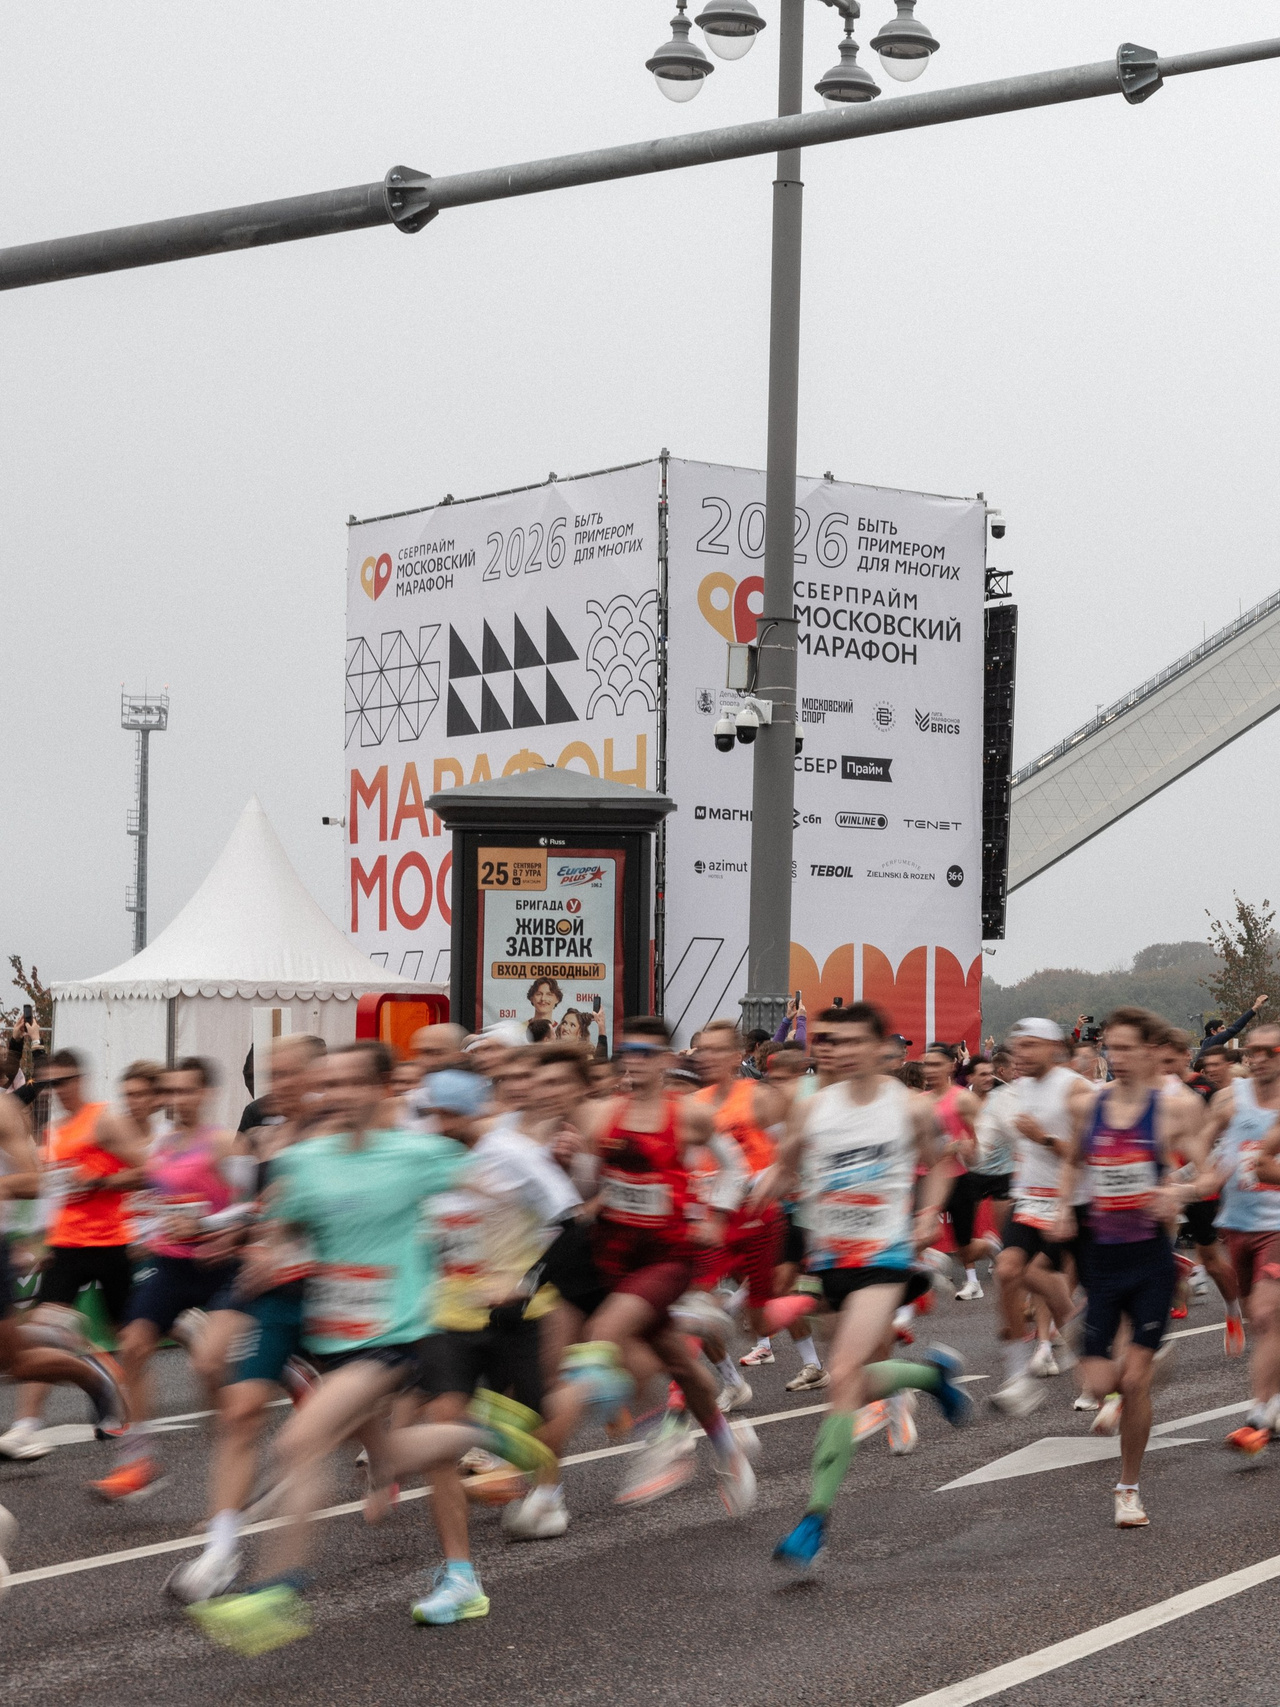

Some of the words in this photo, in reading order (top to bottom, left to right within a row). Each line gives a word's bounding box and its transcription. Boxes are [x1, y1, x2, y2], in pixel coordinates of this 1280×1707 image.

[574, 512, 603, 528] БЫТЬ
[857, 517, 898, 535] БЫТЬ
[574, 522, 634, 545] ПРИМЕРОМ
[398, 538, 455, 560] СБЕРПРАЙМ
[482, 516, 567, 582] 2026
[573, 546, 595, 565] ДЛЯ
[597, 537, 644, 558] МНОГИХ
[857, 536, 946, 560] ПРИМЕРОМ
[396, 548, 476, 579] МОСКОВСКИЙ
[857, 555, 890, 573] ДЛЯ
[894, 559, 961, 580] МНОГИХ
[396, 574, 454, 597] МАРАФОН
[793, 580, 918, 610] СБЕРПРАЙМ
[793, 604, 961, 642] МОСКОВСКИЙ
[797, 633, 917, 665] МАРАФОН
[802, 697, 854, 714] МОСКОВСКИЙ
[802, 710, 826, 724] СПОРТ
[931, 722, 960, 734] BRICS
[793, 756, 837, 774] СБЕР
[846, 761, 883, 776] Прайм
[709, 808, 753, 821] магн
[802, 814, 822, 824] сбп
[839, 815, 876, 826] WINLINE
[903, 819, 962, 831] TENET
[481, 861, 509, 886] 25
[512, 869, 518, 877] В
[519, 869, 524, 877] 7
[525, 869, 542, 877] УТРА
[708, 859, 748, 872] azimut
[810, 864, 854, 878] TEBOIL
[515, 899, 564, 911] БРИГАДА
[505, 936, 593, 958] ЗАВТРАК
[497, 964, 527, 978] ВХОД
[530, 963, 600, 979] СВОБОДНЫЙ
[499, 1009, 516, 1018] ВЭЛ
